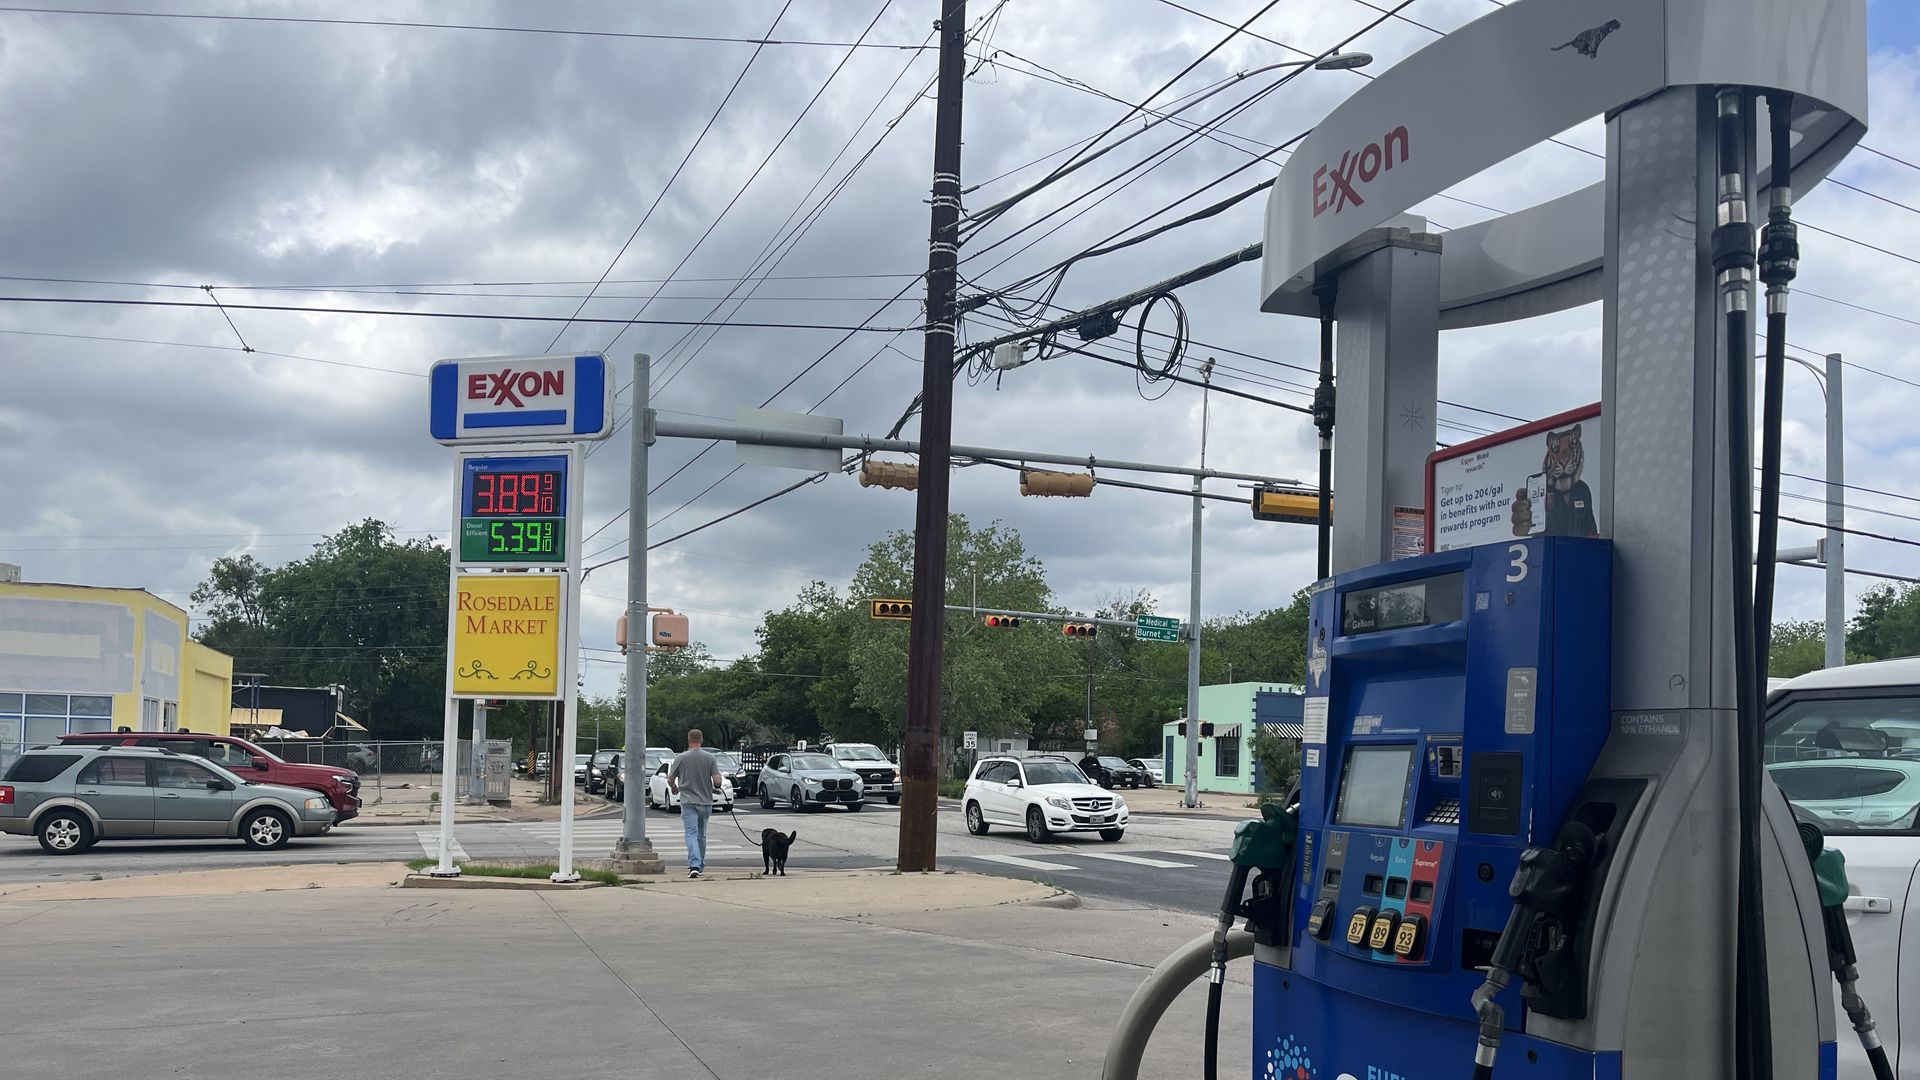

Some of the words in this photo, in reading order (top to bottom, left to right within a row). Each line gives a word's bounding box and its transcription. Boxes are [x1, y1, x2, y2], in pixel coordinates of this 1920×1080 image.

[1312, 125, 1409, 218] Exxon
[468, 368, 564, 408] EXXON
[477, 474, 540, 513] 3.89
[1441, 497, 1453, 507] Get
[1455, 496, 1464, 505] up
[1465, 493, 1473, 501] to
[1475, 482, 1503, 499] 20¢/gal
[1441, 511, 1447, 520] in
[1449, 504, 1478, 519] benefits
[1479, 499, 1496, 512] with
[1498, 497, 1511, 507] our
[1440, 520, 1468, 534] rewards
[1470, 514, 1501, 530] program
[491, 522, 542, 552] 5.39
[1507, 543, 1528, 582] 3
[457, 591, 555, 612] ROSEDALE
[466, 615, 548, 635] MARKET
[1145, 618, 1169, 627] Medical
[1352, 619, 1375, 629] Gallons
[1137, 628, 1161, 638] Burnet
[1621, 713, 1664, 724] CONTAINS
[1638, 724, 1680, 735] ETHANOL
[1351, 922, 1364, 936] 87
[1373, 926, 1388, 940] 89
[1399, 931, 1413, 946] 93
